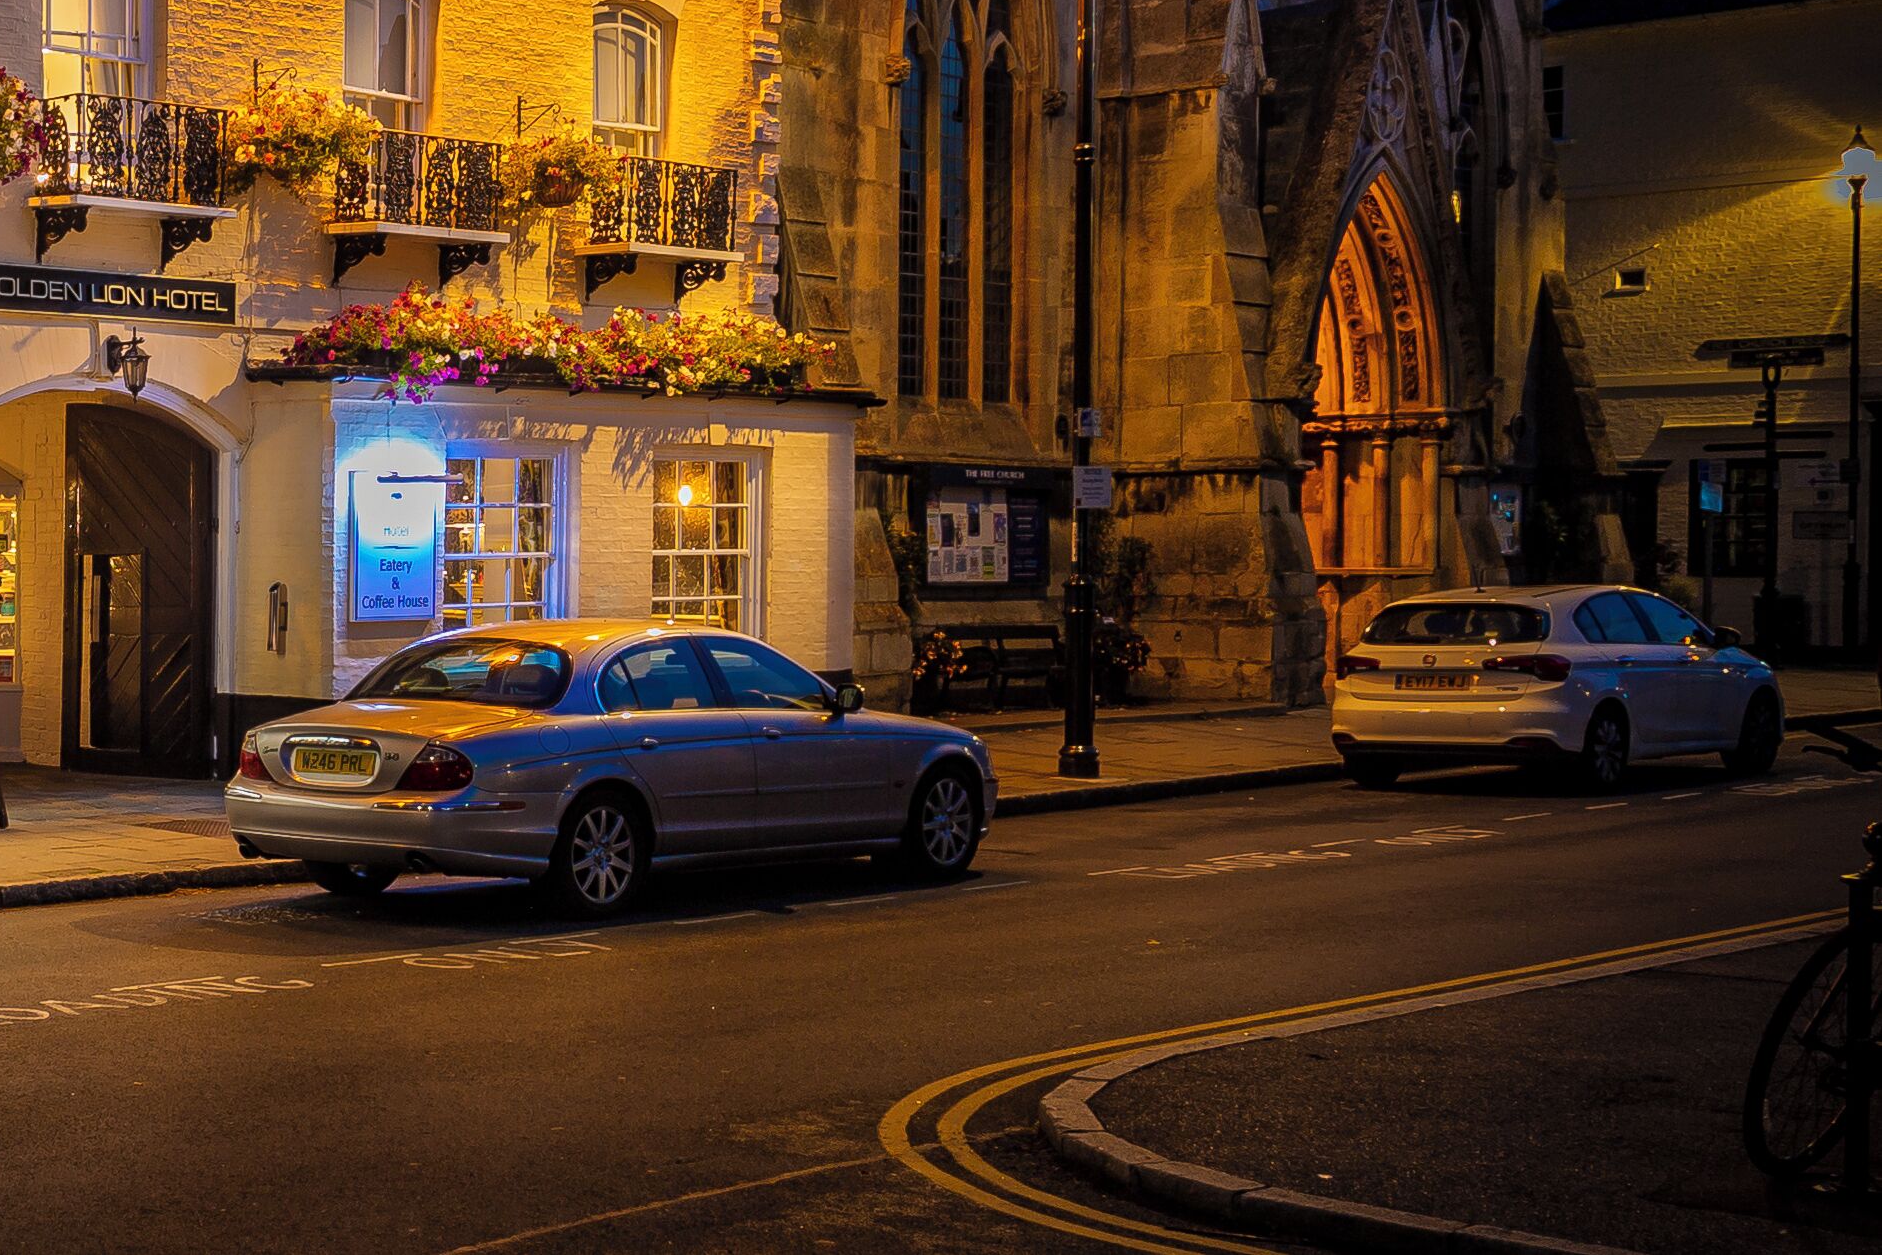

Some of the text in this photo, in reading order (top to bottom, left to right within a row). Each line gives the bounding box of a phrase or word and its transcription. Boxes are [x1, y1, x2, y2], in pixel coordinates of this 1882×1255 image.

[91, 283, 145, 306] LION
[153, 288, 228, 312] HOTEL
[965, 469, 1025, 479] THE FREE CHURCH
[379, 559, 412, 574] Eatery
[391, 577, 400, 590] &
[362, 595, 429, 609] Coffee House
[1404, 675, 1435, 688] EY17
[340, 754, 367, 772] PRL
[403, 939, 612, 969] ONLY
